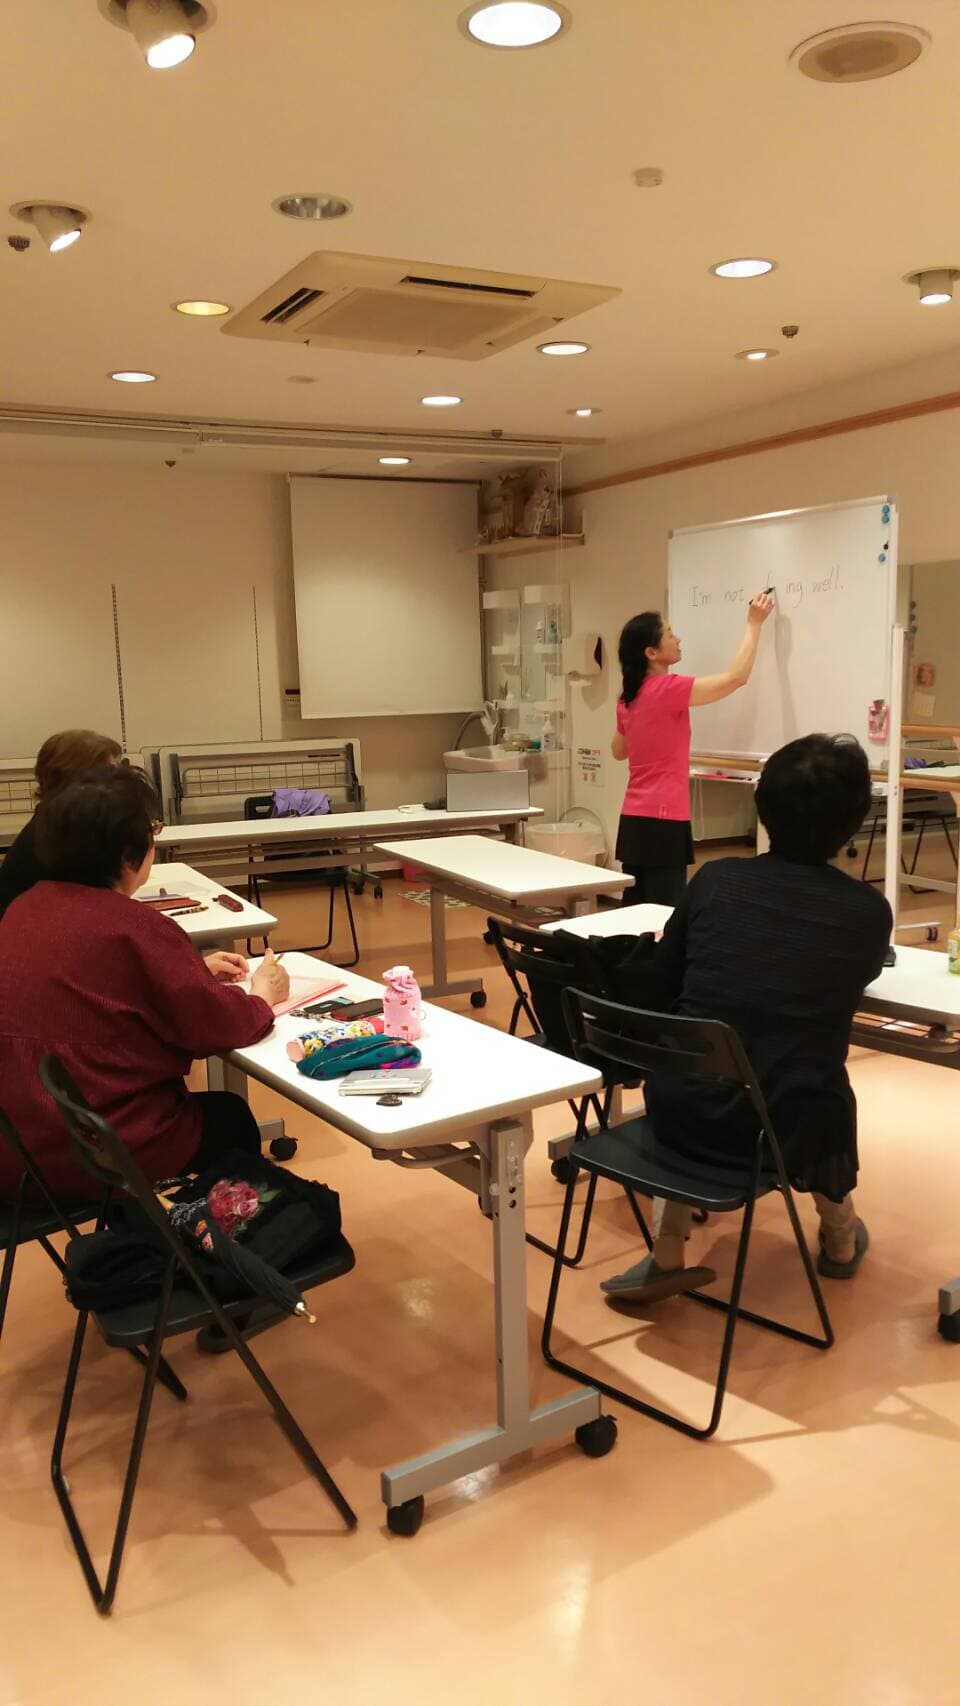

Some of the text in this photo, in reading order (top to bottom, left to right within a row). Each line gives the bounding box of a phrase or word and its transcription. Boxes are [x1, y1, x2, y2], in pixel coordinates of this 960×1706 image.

[688, 585, 711, 608] I'm
[724, 587, 745, 602] not
[812, 564, 844, 593] well.
